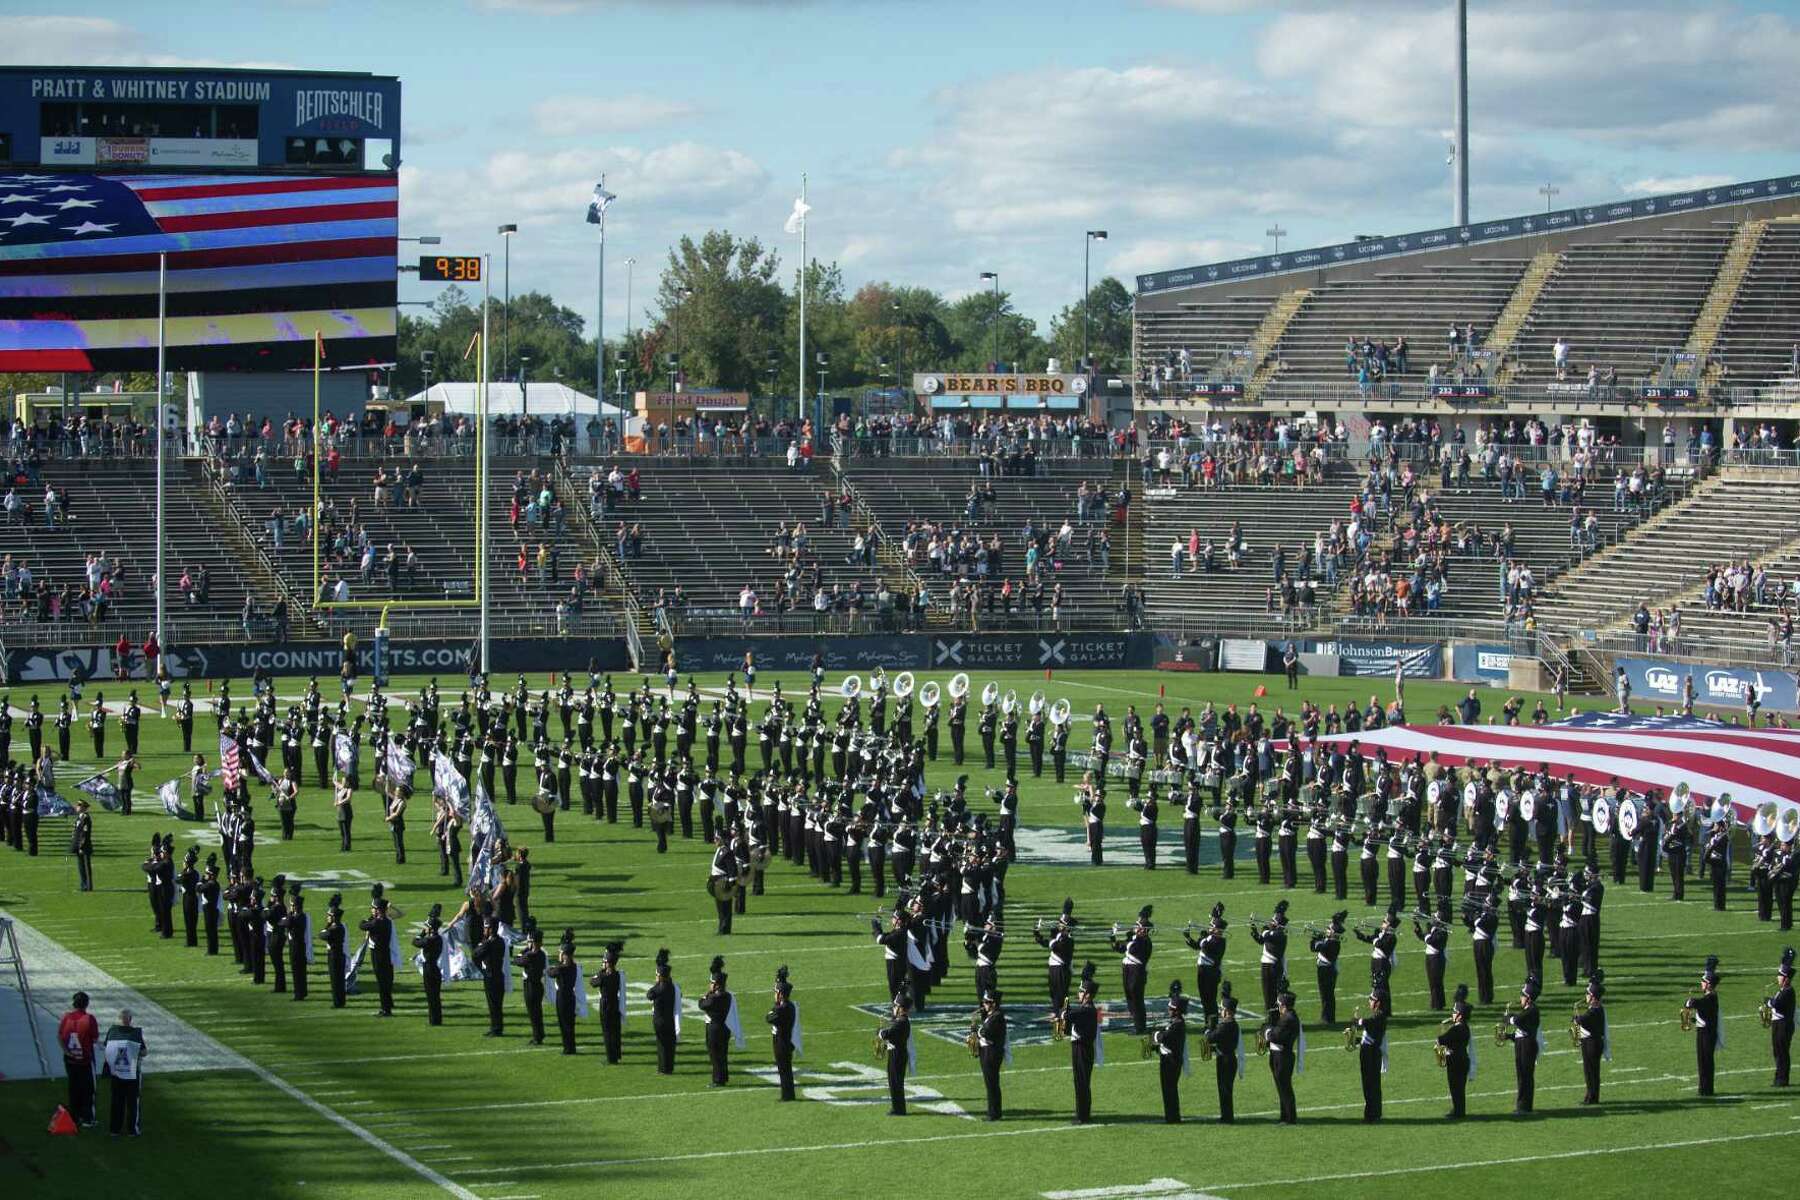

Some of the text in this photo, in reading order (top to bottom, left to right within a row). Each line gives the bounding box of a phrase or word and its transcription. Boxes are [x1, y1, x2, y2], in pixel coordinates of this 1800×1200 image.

[31, 79, 271, 101] PRATT & WHITNEY STADIUM
[296, 90, 383, 129] RENTSCHLER
[946, 378, 1065, 394] BEAR'S BBQ
[1438, 387, 1453, 395] 232
[1465, 387, 1479, 395] 231
[1647, 389, 1661, 397] 231
[1674, 389, 1689, 397] 230
[696, 394, 738, 407] Dough
[968, 643, 1023, 653] TICKET
[1070, 642, 1125, 652] TICKET
[240, 648, 473, 669] UCONNTIKTS.COM
[967, 654, 1022, 663] GALAXY
[1070, 653, 1125, 662] GALAXY
[1649, 673, 1678, 690] LAZ
[1709, 676, 1739, 693] LAZ
